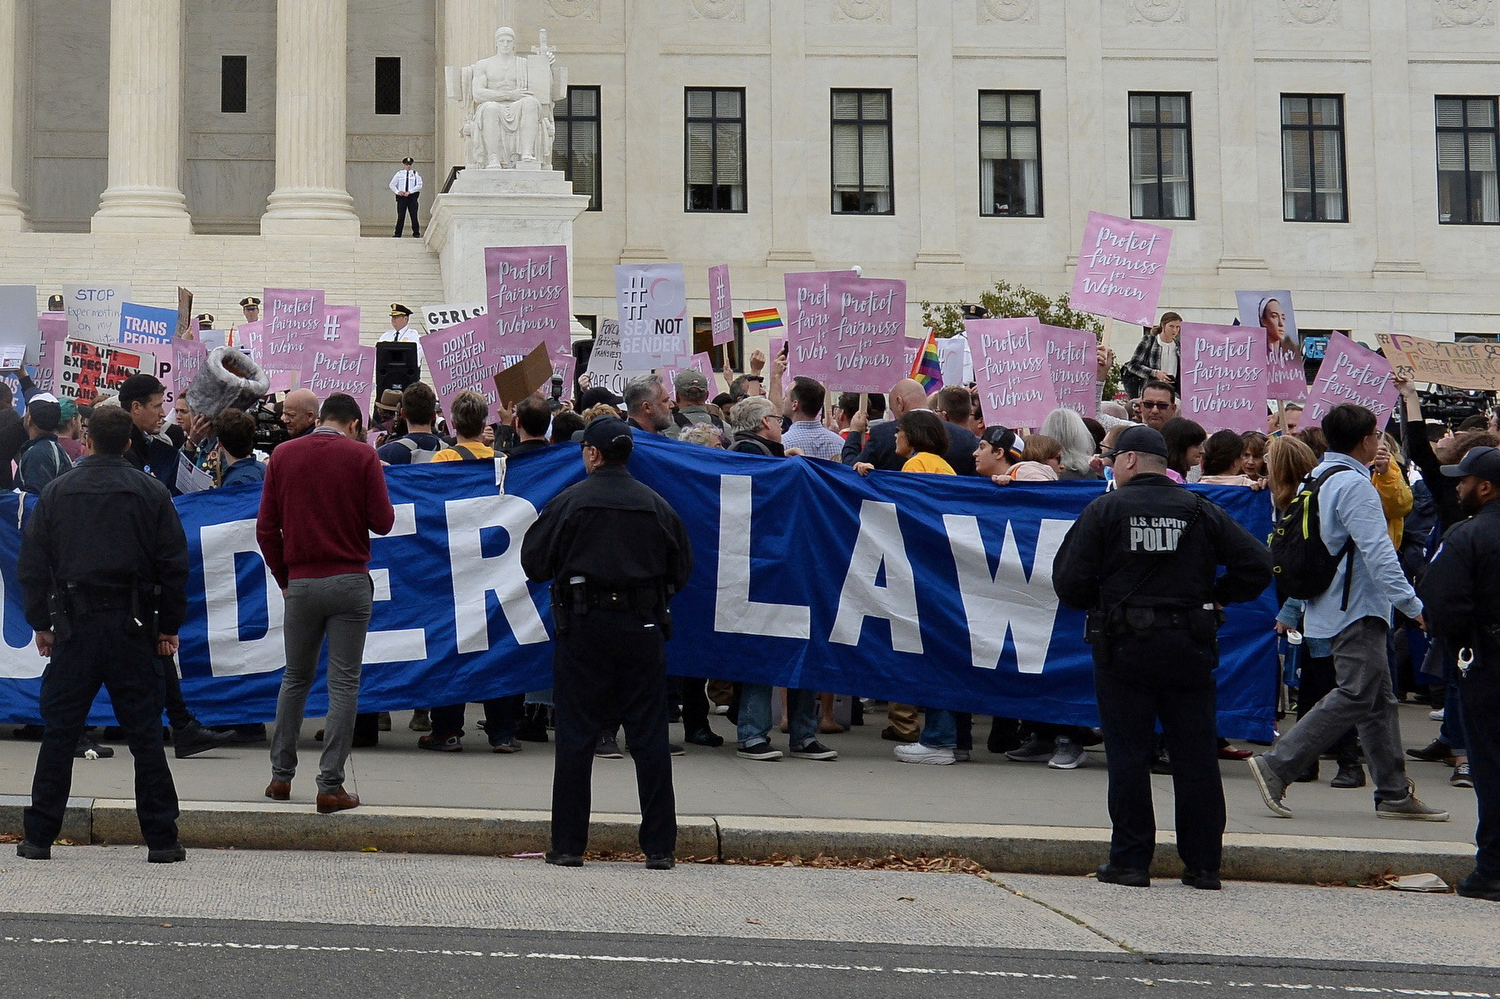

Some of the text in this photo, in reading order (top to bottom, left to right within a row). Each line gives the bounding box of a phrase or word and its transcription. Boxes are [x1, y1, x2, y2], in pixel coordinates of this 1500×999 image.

[1096, 226, 1161, 255] Protect
[500, 255, 558, 285] Protect
[1083, 248, 1161, 274] fairness
[75, 289, 115, 301] STOP
[491, 284, 565, 308] fairness
[1083, 277, 1149, 301] Women
[273, 297, 317, 316] Protect
[841, 289, 898, 317] Protect
[124, 315, 168, 336] TRANS
[266, 315, 321, 334] fairness
[496, 315, 558, 337] Women
[654, 318, 683, 334] NOT
[832, 317, 903, 341] fairness
[66, 341, 119, 361] THE LIFE
[442, 330, 476, 355] DON'T
[621, 336, 680, 353] GENDER
[980, 326, 1034, 357] Protect
[1194, 335, 1258, 361] Protect
[313, 350, 367, 376] Protect
[437, 341, 486, 370] THREATEN
[613, 360, 623, 371] IS
[835, 352, 895, 371] Women
[441, 363, 500, 396] OPPORTUNITY
[450, 357, 484, 380] EQUAL
[977, 356, 1045, 381] fairness
[1185, 360, 1264, 385] fairness
[1334, 351, 1393, 394] Protect
[303, 373, 369, 394] fairness
[1319, 376, 1390, 415] fairness
[986, 386, 1045, 410] Women
[1189, 393, 1256, 414] Women
[1129, 516, 1149, 527] U.S.
[714, 474, 1075, 674] LAW
